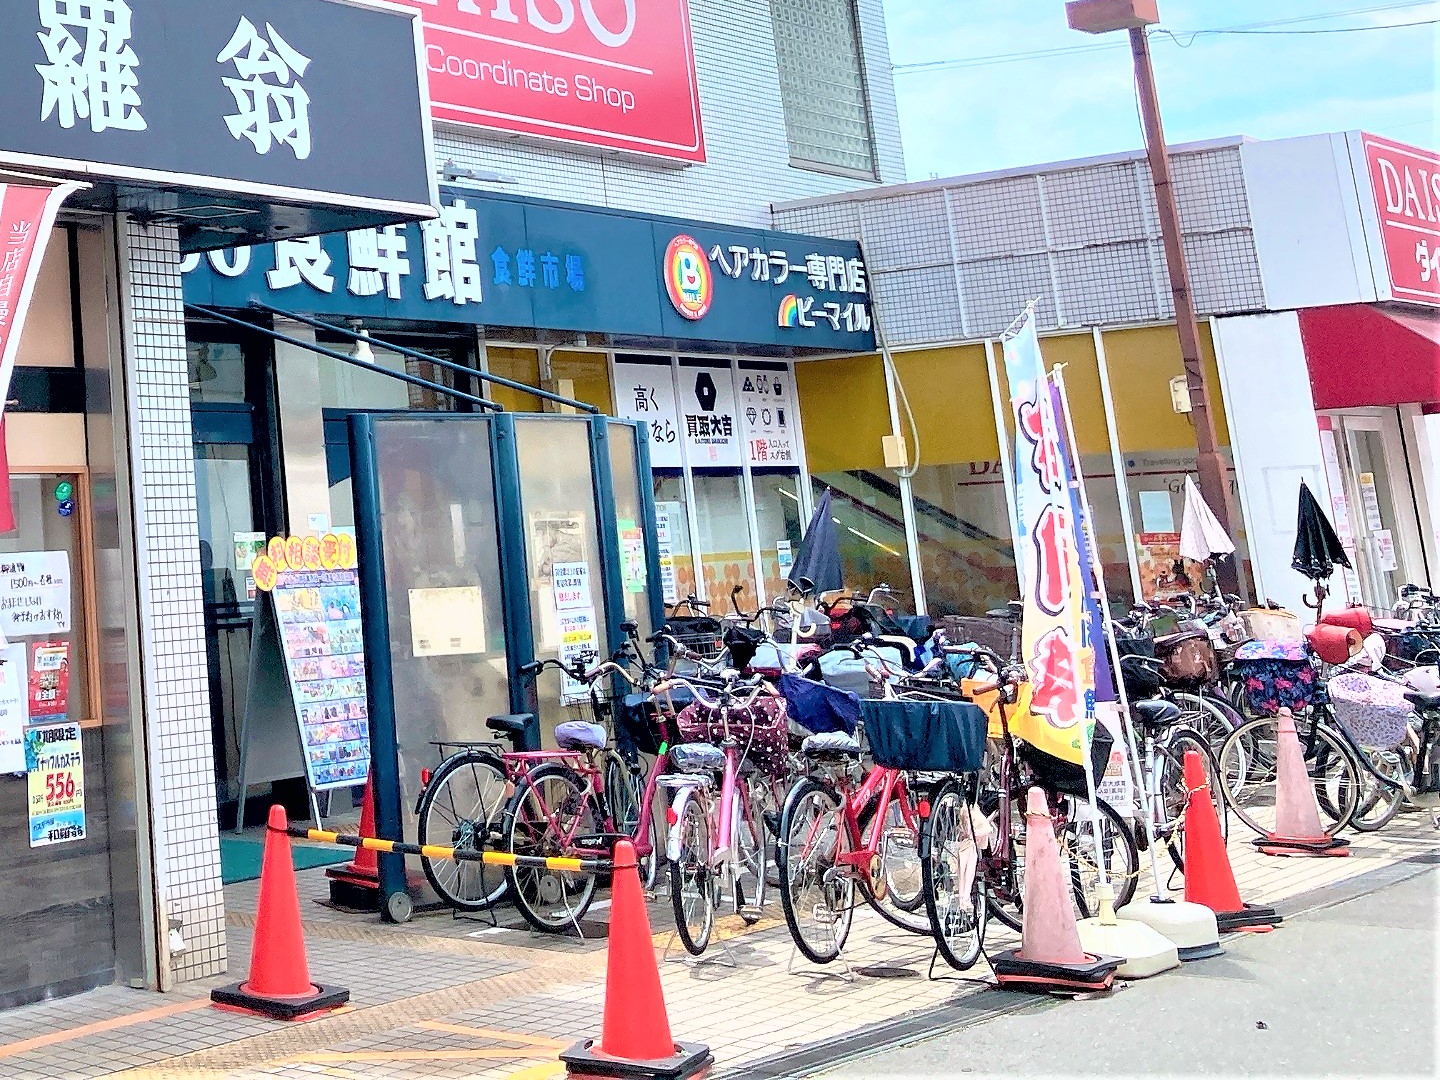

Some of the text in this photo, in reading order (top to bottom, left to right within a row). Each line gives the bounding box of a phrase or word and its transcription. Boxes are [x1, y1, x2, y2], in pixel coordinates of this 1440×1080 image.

[426, 44, 636, 115] Coordinate Shop
[490, 245, 586, 293] 食鮮市場
[709, 244, 867, 294] ヘアカラー専門店
[797, 295, 871, 333] ビーマイル
[633, 384, 660, 413] 高く
[685, 413, 733, 438] 買取大吉
[750, 438, 768, 461] 1階
